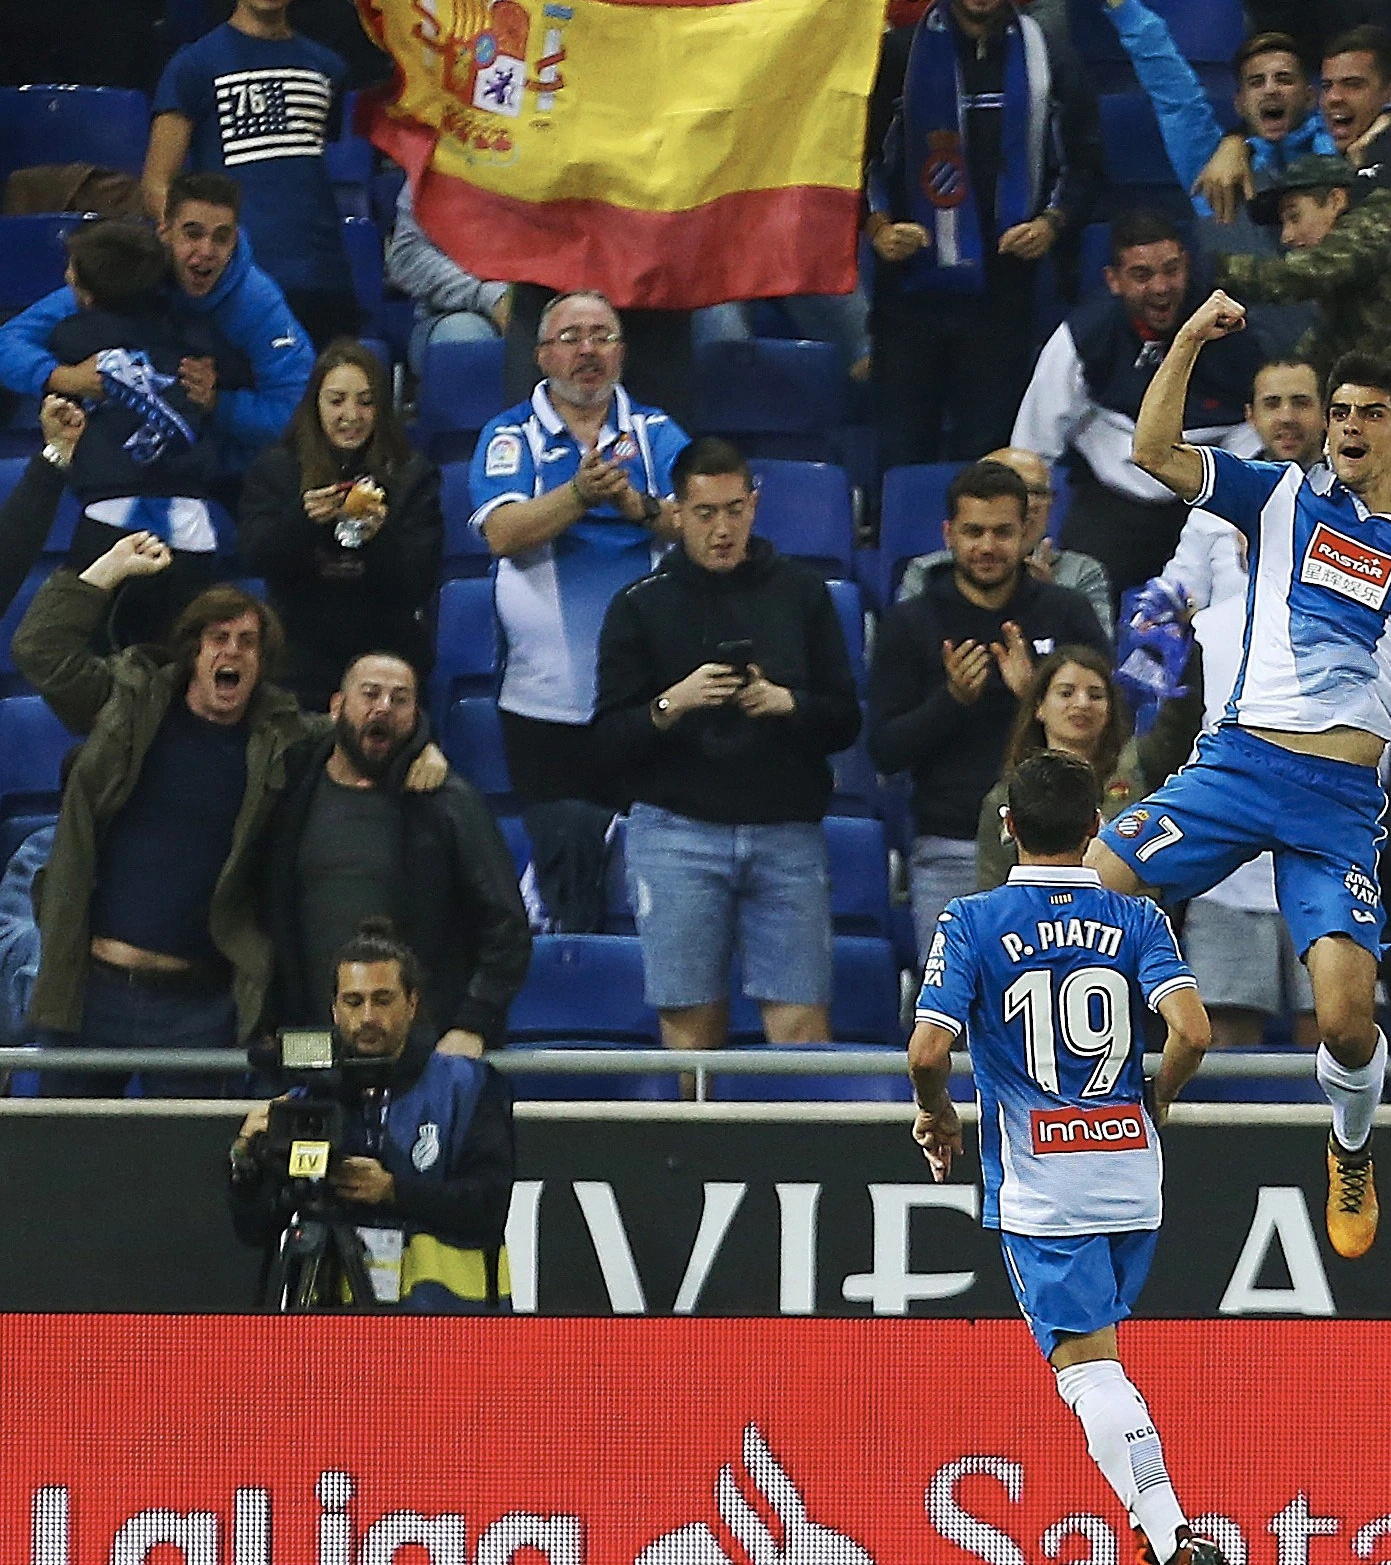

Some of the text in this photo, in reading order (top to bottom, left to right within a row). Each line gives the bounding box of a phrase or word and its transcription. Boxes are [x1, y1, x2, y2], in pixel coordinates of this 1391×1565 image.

[231, 83, 266, 116] 76
[1318, 543, 1384, 579] RASTAR
[1305, 562, 1381, 605] 星辉娱乐
[1136, 815, 1184, 863] 7
[1001, 918, 1124, 963] P. PIATTI
[1004, 967, 1132, 1098] 19
[297, 1153, 319, 1169] TV
